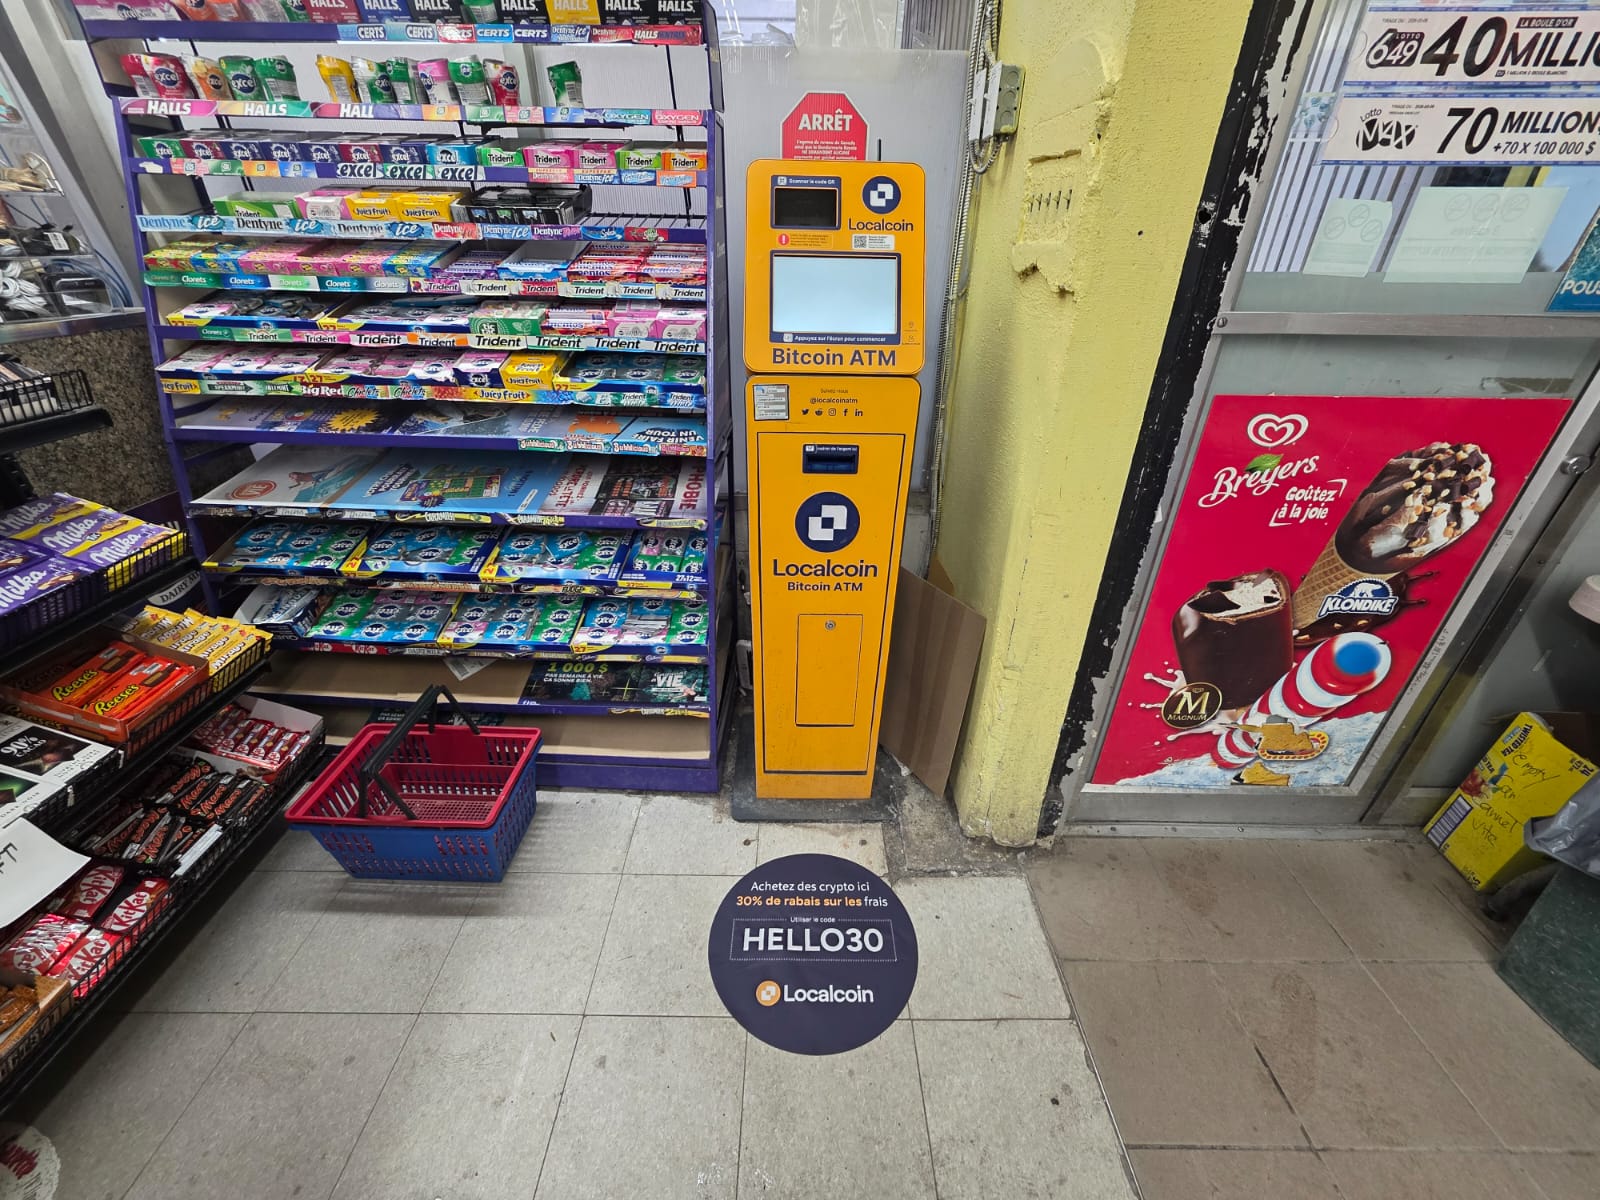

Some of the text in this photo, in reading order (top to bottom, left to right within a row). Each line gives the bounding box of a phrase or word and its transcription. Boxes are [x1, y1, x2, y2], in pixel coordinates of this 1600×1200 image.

[605, 0, 642, 11] HALLS.
[658, 1, 695, 12] HALLS.
[1520, 18, 1575, 27] LA BOULE D'OR
[357, 26, 385, 39] CERTS
[406, 26, 433, 39] CERTS
[477, 29, 510, 38] CERTS
[514, 29, 548, 38] CERTS
[634, 30, 659, 39] HALLS
[1420, 16, 1508, 77] 40
[1498, 31, 1600, 67] MILLI
[147, 101, 192, 115] HALLS
[244, 103, 288, 117] HALLS
[340, 104, 374, 118] HALL
[604, 112, 649, 120] OXYGEN
[798, 108, 853, 132] ARRÊT
[1360, 108, 1382, 122] Lotto
[1436, 106, 1600, 155] 70 MILLION
[1493, 141, 1597, 155] +70 X 100 000 $
[488, 153, 514, 163] Trident
[534, 154, 561, 164] Trident
[580, 155, 607, 165] Trident
[626, 157, 653, 167] Trident
[671, 158, 698, 167] Trident
[340, 162, 376, 178] excel
[390, 164, 427, 179] excel
[440, 165, 477, 181] excel
[141, 216, 220, 230] Dentyne ice
[235, 218, 317, 233] Dentyne ice
[337, 223, 422, 236] Dentyne ice
[848, 217, 914, 232] Localcoin
[533, 226, 563, 236] Dentyne
[182, 275, 206, 284] Clorets
[229, 277, 254, 286] Clorets
[325, 279, 350, 288] Clorets
[476, 283, 507, 292] Trident
[525, 283, 556, 292] Trident
[574, 285, 605, 295] Trident
[622, 285, 654, 295] Trident
[672, 288, 705, 297] Trident
[304, 335, 337, 344] Trident
[356, 333, 402, 345] Trident
[418, 337, 456, 347] Trident
[475, 335, 521, 347] Trident
[535, 336, 581, 349] Trident
[594, 338, 640, 350] Trident
[794, 335, 817, 343] Appuyez
[653, 341, 699, 353] Trident
[772, 347, 896, 366] Bitcoin ATM
[347, 386, 379, 398] Chiclets
[393, 386, 425, 399] Chiclets
[480, 390, 525, 400] Juicy Fruit
[621, 393, 646, 401] Trident
[809, 397, 858, 405] @localcoinatm
[645, 429, 677, 437] TOUR
[665, 435, 705, 444] VENIR
[1198, 455, 1320, 508] Breyers
[1285, 485, 1338, 502] Goûtez
[1277, 503, 1329, 524] à la joie
[42, 518, 98, 548] Milka
[90, 533, 142, 564] Milka
[772, 558, 878, 578] Localcoin
[0, 570, 48, 608] Milka
[787, 581, 863, 592] Bitcoin ATM
[1318, 596, 1396, 618] KLONDIKE
[594, 616, 618, 625] excel
[680, 614, 703, 623] excel
[211, 642, 245, 670] Mirage
[547, 662, 608, 674] 1 000 $
[52, 668, 99, 701] Reese's
[656, 674, 683, 687] VIE
[94, 684, 140, 716] Reese's
[1174, 691, 1210, 714] M
[1167, 713, 1208, 721] MAGNUM
[1511, 723, 1534, 749] TWISTED
[1, 735, 39, 755] 90%
[16, 739, 47, 758] CACAO
[750, 881, 870, 894] Achetez des crypto ici
[736, 895, 888, 908] 30% de rabais sur les frais
[113, 892, 148, 930] KitKat
[742, 927, 884, 952] HELLO30
[783, 984, 875, 1003] Localcoin
